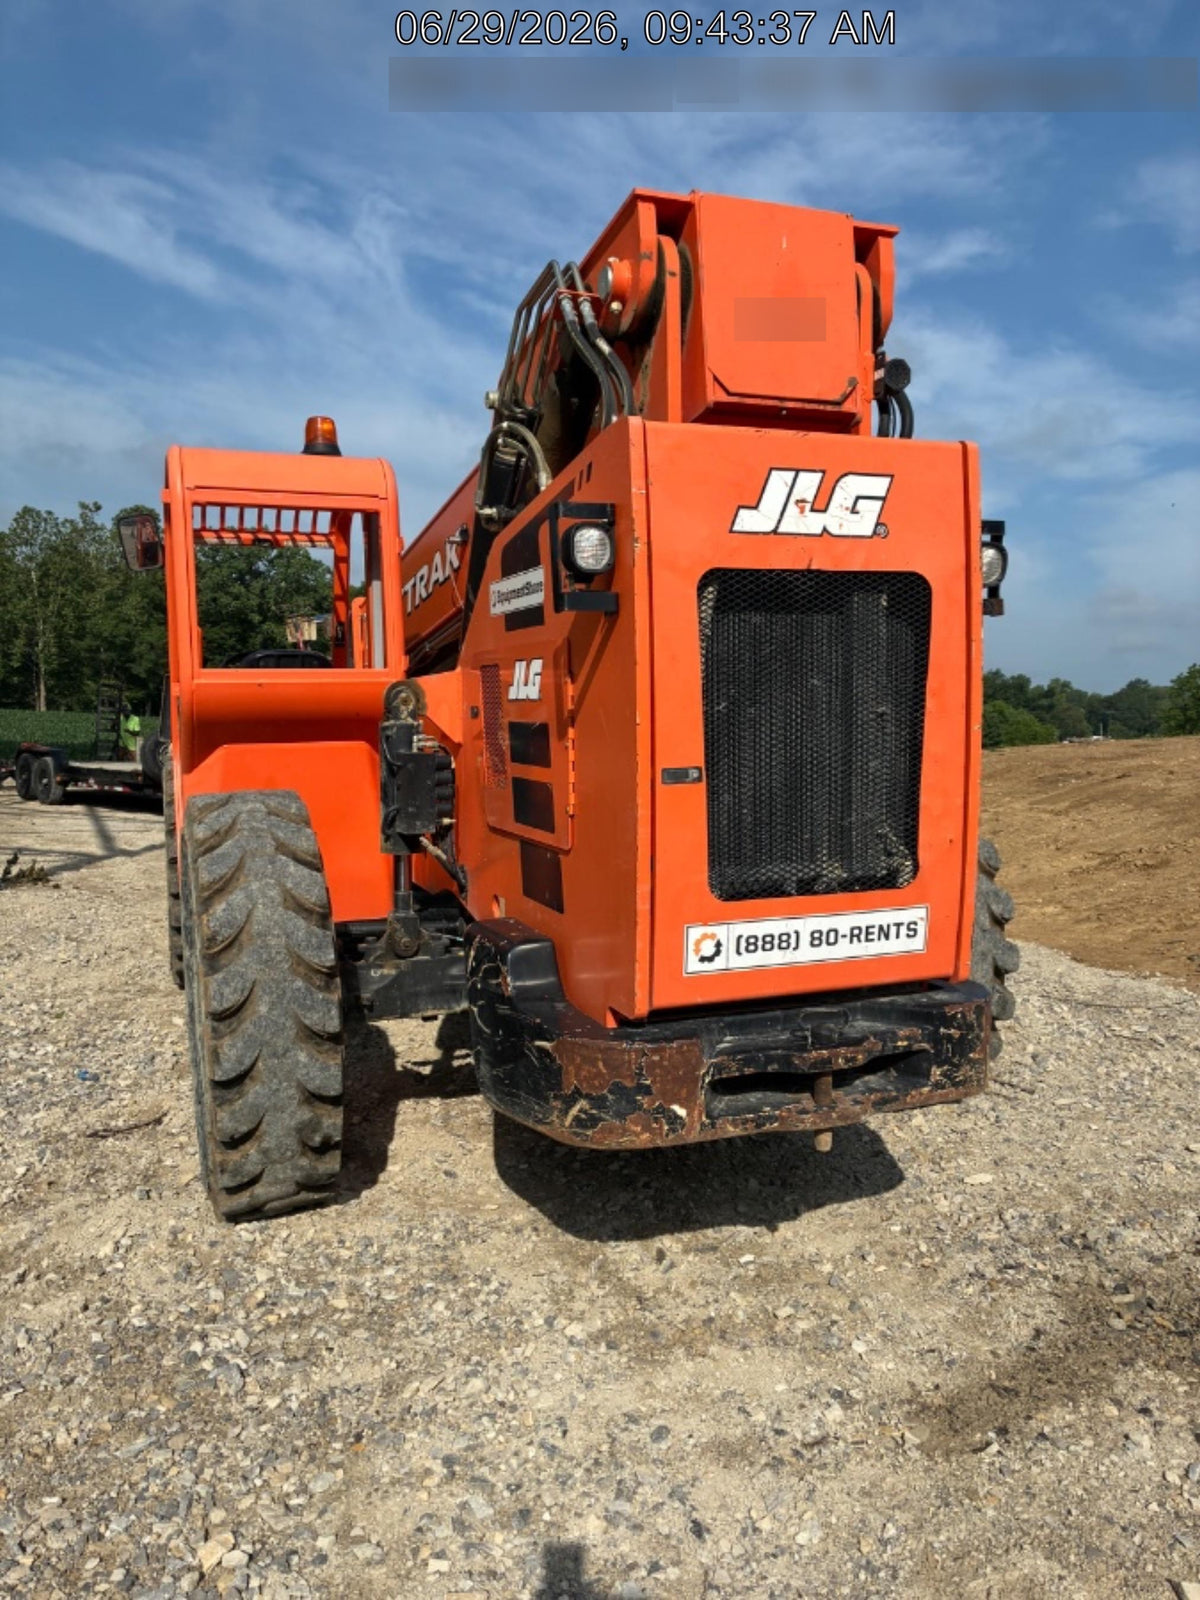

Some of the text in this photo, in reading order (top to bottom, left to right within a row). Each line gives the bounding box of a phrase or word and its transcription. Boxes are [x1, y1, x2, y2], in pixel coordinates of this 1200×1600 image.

[508, 658, 543, 701] JLG
[735, 921, 919, 956] (888) 80-RENTS
